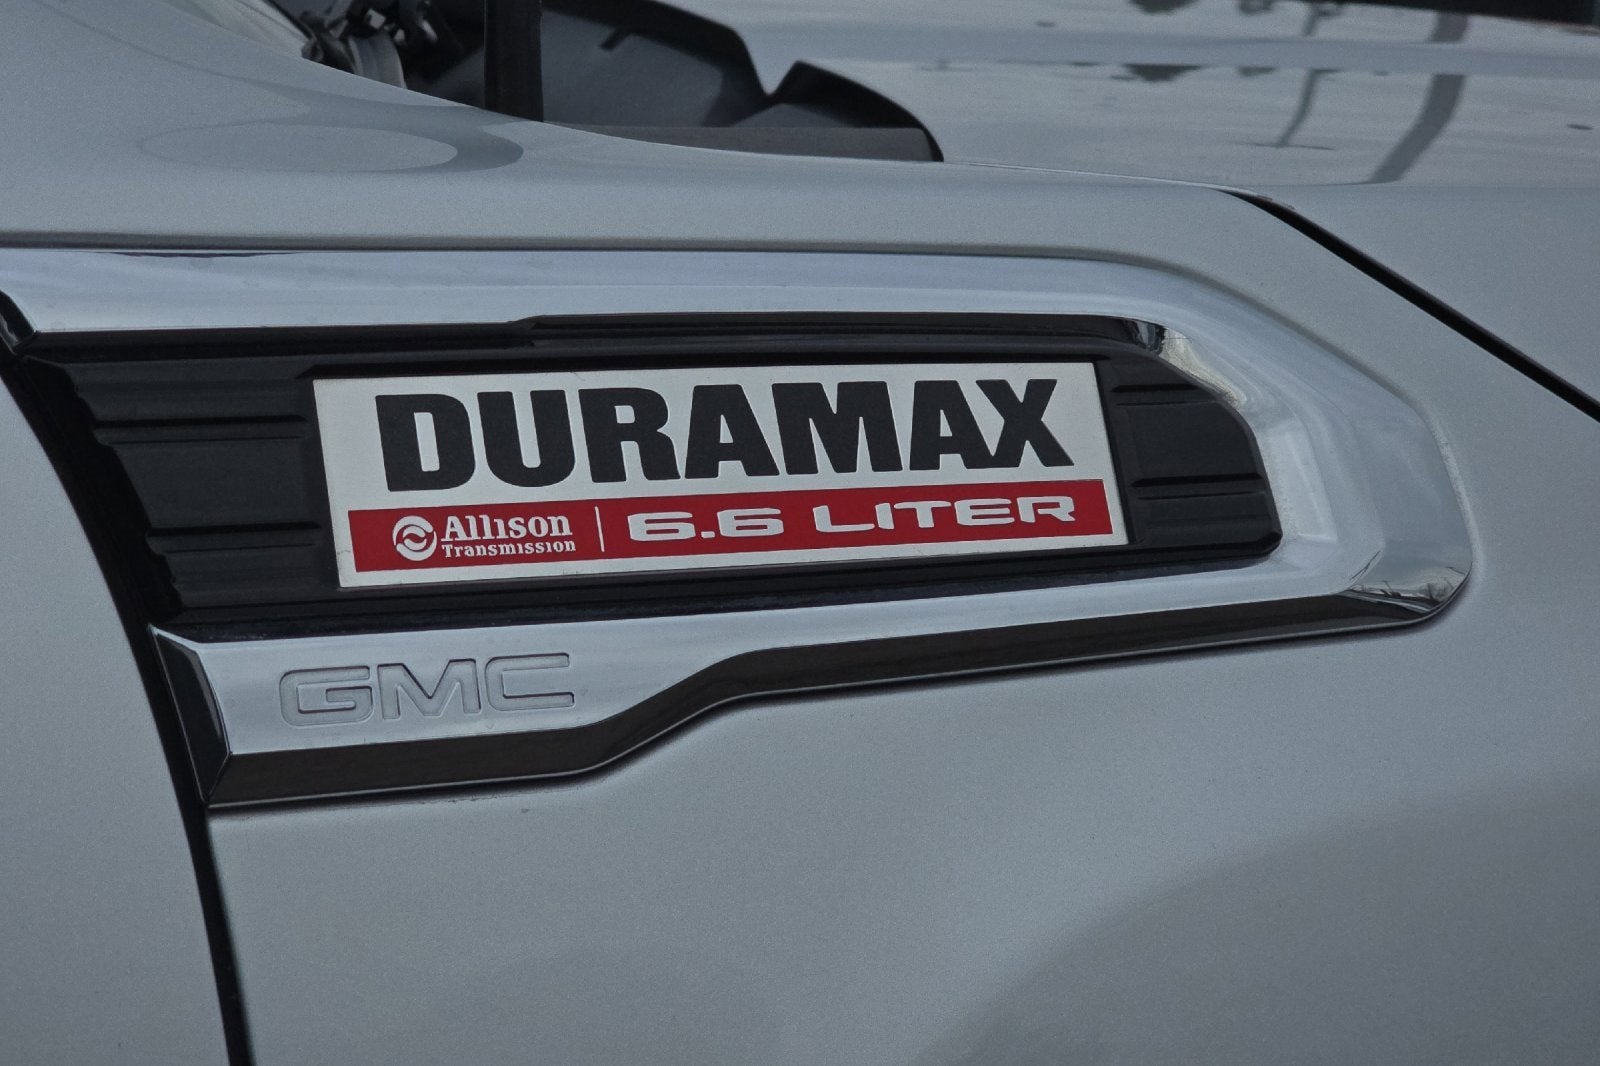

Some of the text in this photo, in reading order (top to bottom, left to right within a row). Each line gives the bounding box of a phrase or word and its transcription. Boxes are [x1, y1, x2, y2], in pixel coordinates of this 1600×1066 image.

[375, 379, 1074, 492] DURAMAX
[441, 513, 573, 542] Allison
[627, 495, 1076, 542] 6.6 LITER
[441, 540, 576, 558] Transmission
[279, 652, 576, 727] GMC
